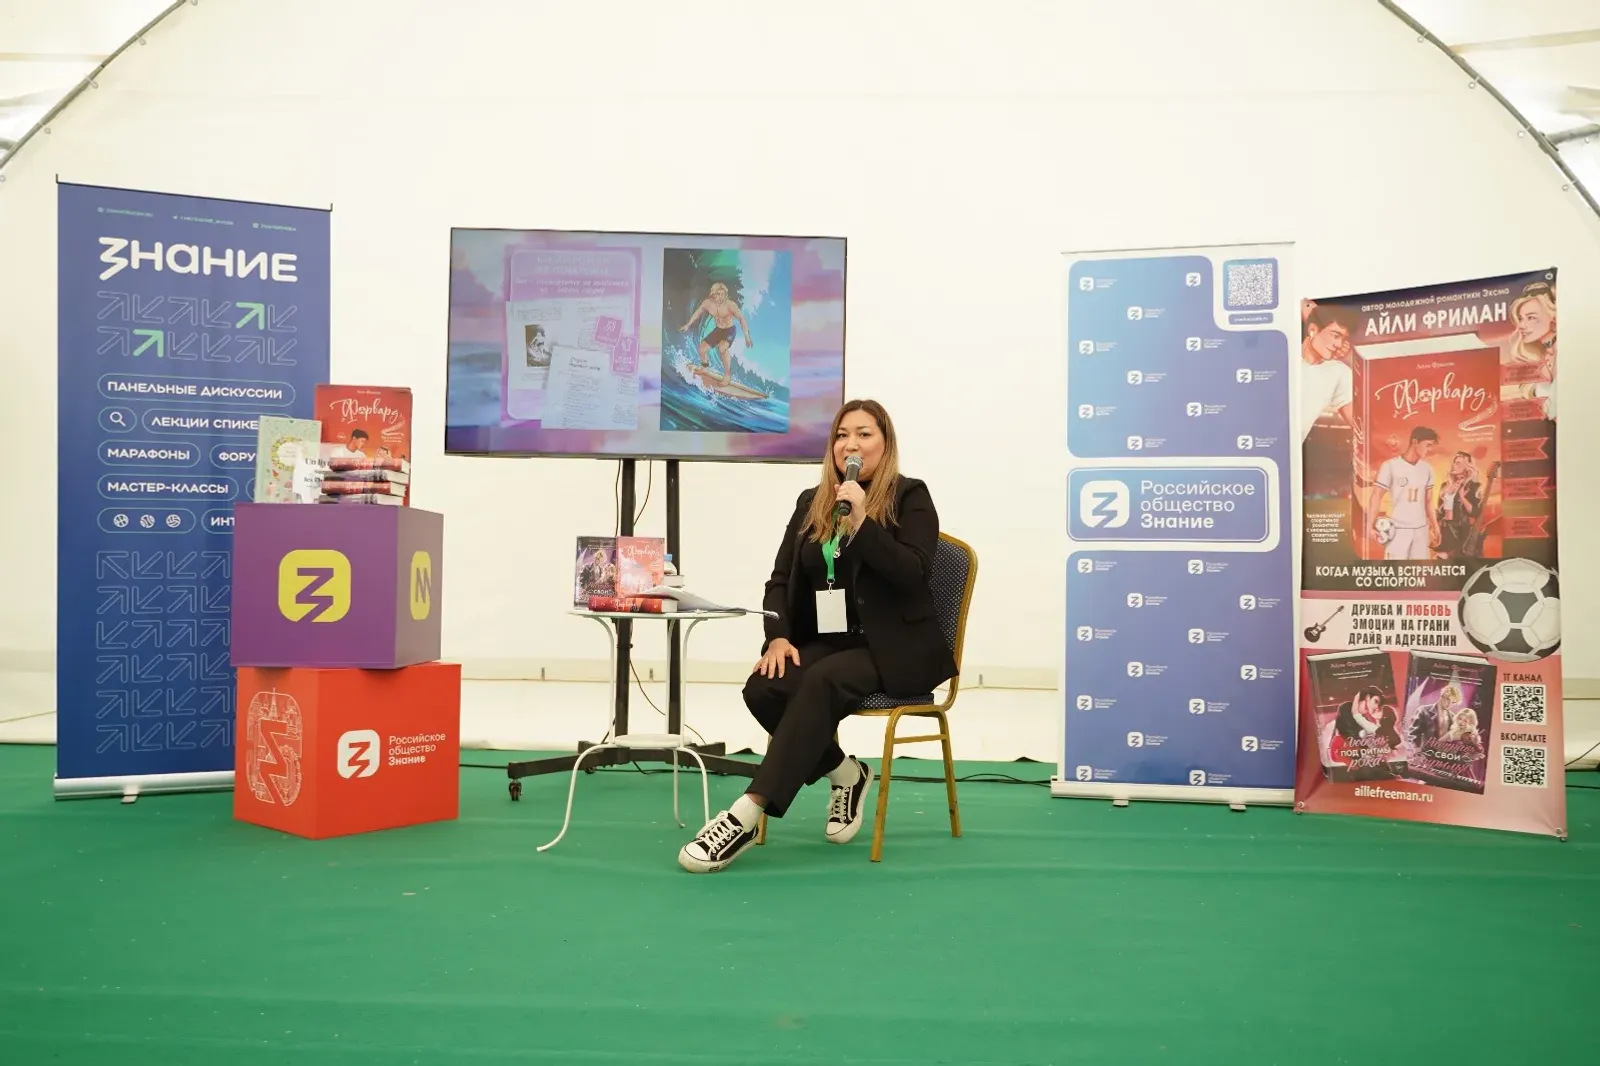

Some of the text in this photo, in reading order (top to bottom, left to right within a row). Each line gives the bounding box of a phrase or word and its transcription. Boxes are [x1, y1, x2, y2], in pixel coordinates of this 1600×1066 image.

[1361, 288, 1510, 312] автор молодежной романтики Эксмо
[1365, 302, 1507, 336] АЙЛИ ФРИМАН
[107, 381, 283, 399] ПАНЕЛЬНЫЕ ДИСКУССИИ
[151, 416, 260, 430] ЛЕКЦИИ СПИКЕ
[107, 448, 190, 460] МАРАФОНЫ
[218, 451, 257, 462] ФОРУ
[107, 481, 229, 494] МАСТЕР-КЛАССЫ
[1140, 480, 1255, 496] Российское
[1140, 497, 1235, 513] общество
[210, 516, 235, 527] ИНТ
[1140, 514, 1214, 529] Знание
[1315, 565, 1466, 577] КОГДА МУЗЫКА ВСТРЕЧАЕТСЯ
[1355, 577, 1426, 587] СО СПОРТОМ
[1351, 604, 1451, 617] ДРУЖБА И ЛЮБОВЬ
[1352, 618, 1450, 632] ЭМОЦИИ НА ГРАНИ
[1348, 631, 1382, 646] ДРАЙВ
[1395, 634, 1457, 647] АДРЕНАЛИН
[1513, 673, 1542, 682] КАНАЛ
[389, 733, 446, 745] Российское
[1500, 732, 1547, 743] ВКОНТАКТЕ
[388, 744, 436, 756] общество
[388, 755, 426, 766] Знание
